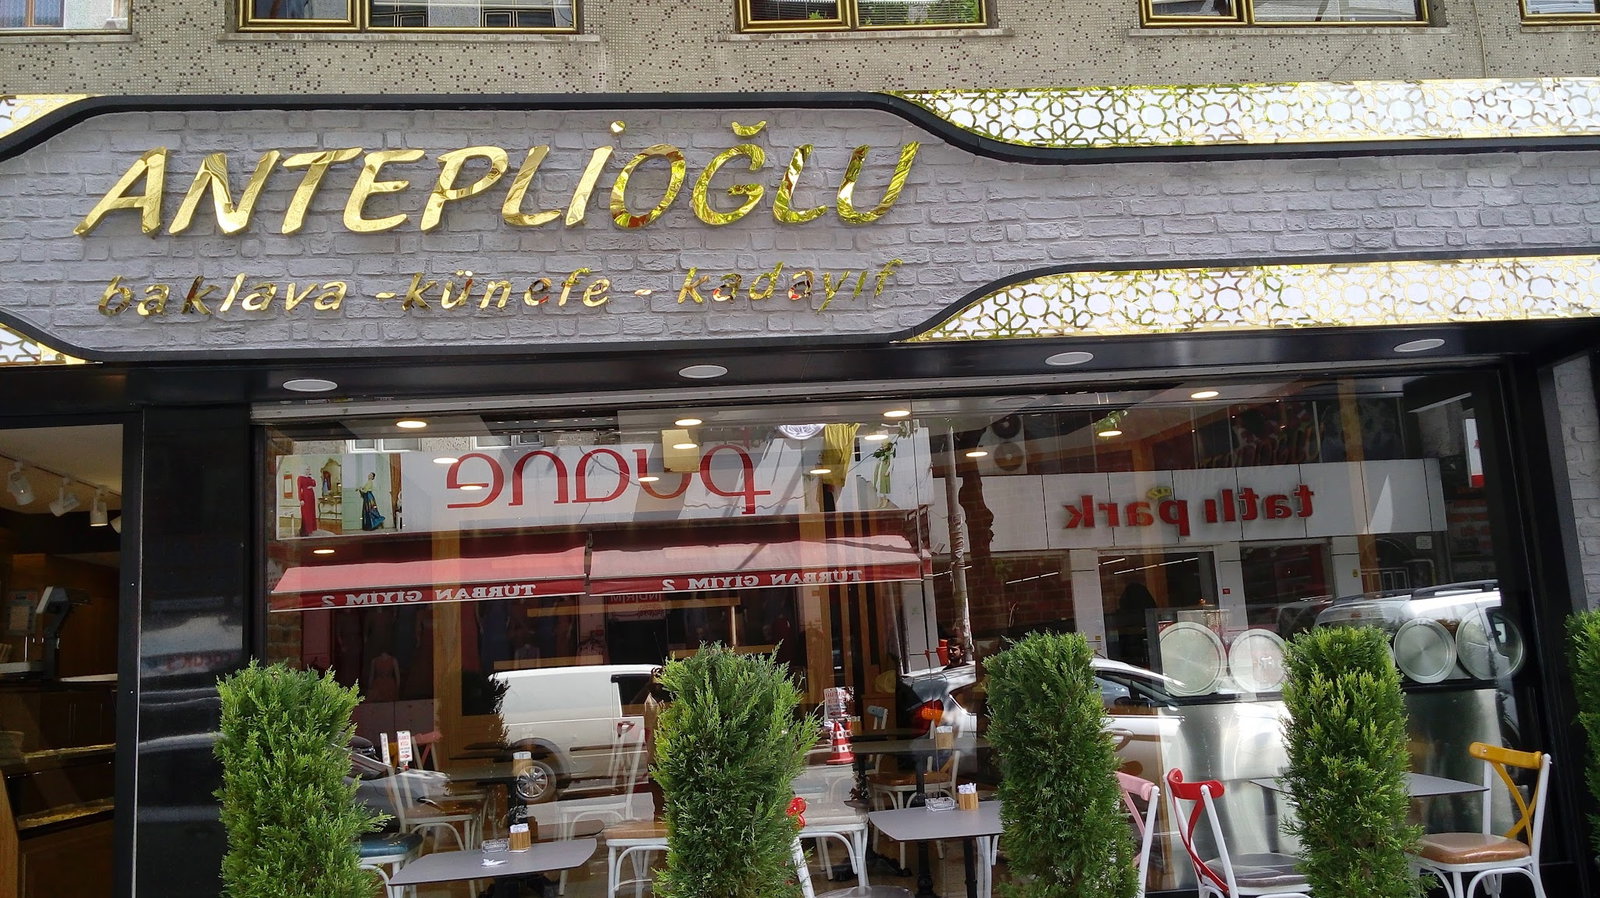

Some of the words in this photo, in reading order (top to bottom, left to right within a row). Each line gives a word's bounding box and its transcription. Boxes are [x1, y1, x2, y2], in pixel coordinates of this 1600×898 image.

[73, 120, 921, 236] ANTEPLİOĞLU
[98, 272, 347, 316] baklava
[678, 259, 903, 313] kadayıf
